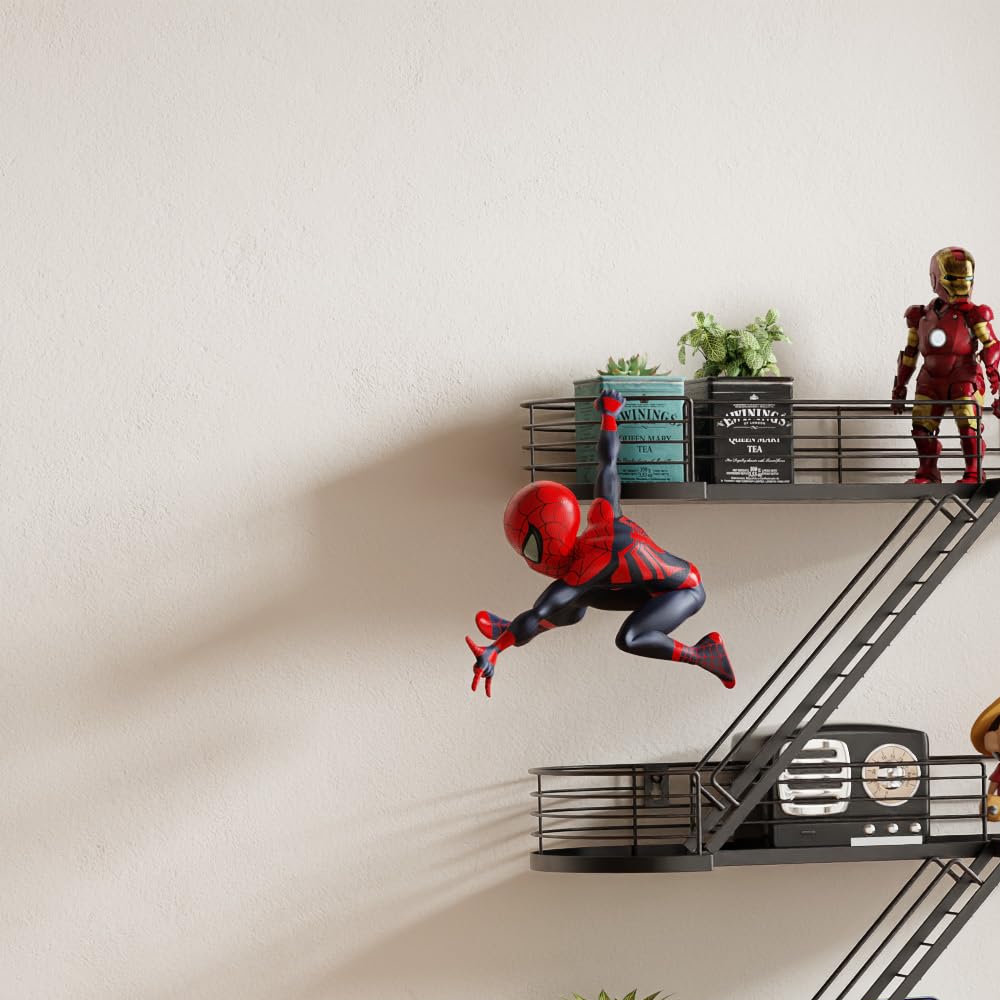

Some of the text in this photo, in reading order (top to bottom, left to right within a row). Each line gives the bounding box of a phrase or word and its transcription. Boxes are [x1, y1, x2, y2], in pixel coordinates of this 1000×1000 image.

[619, 408, 679, 426] WININGS
[636, 445, 653, 453] TEA
[747, 445, 763, 453] TEA
